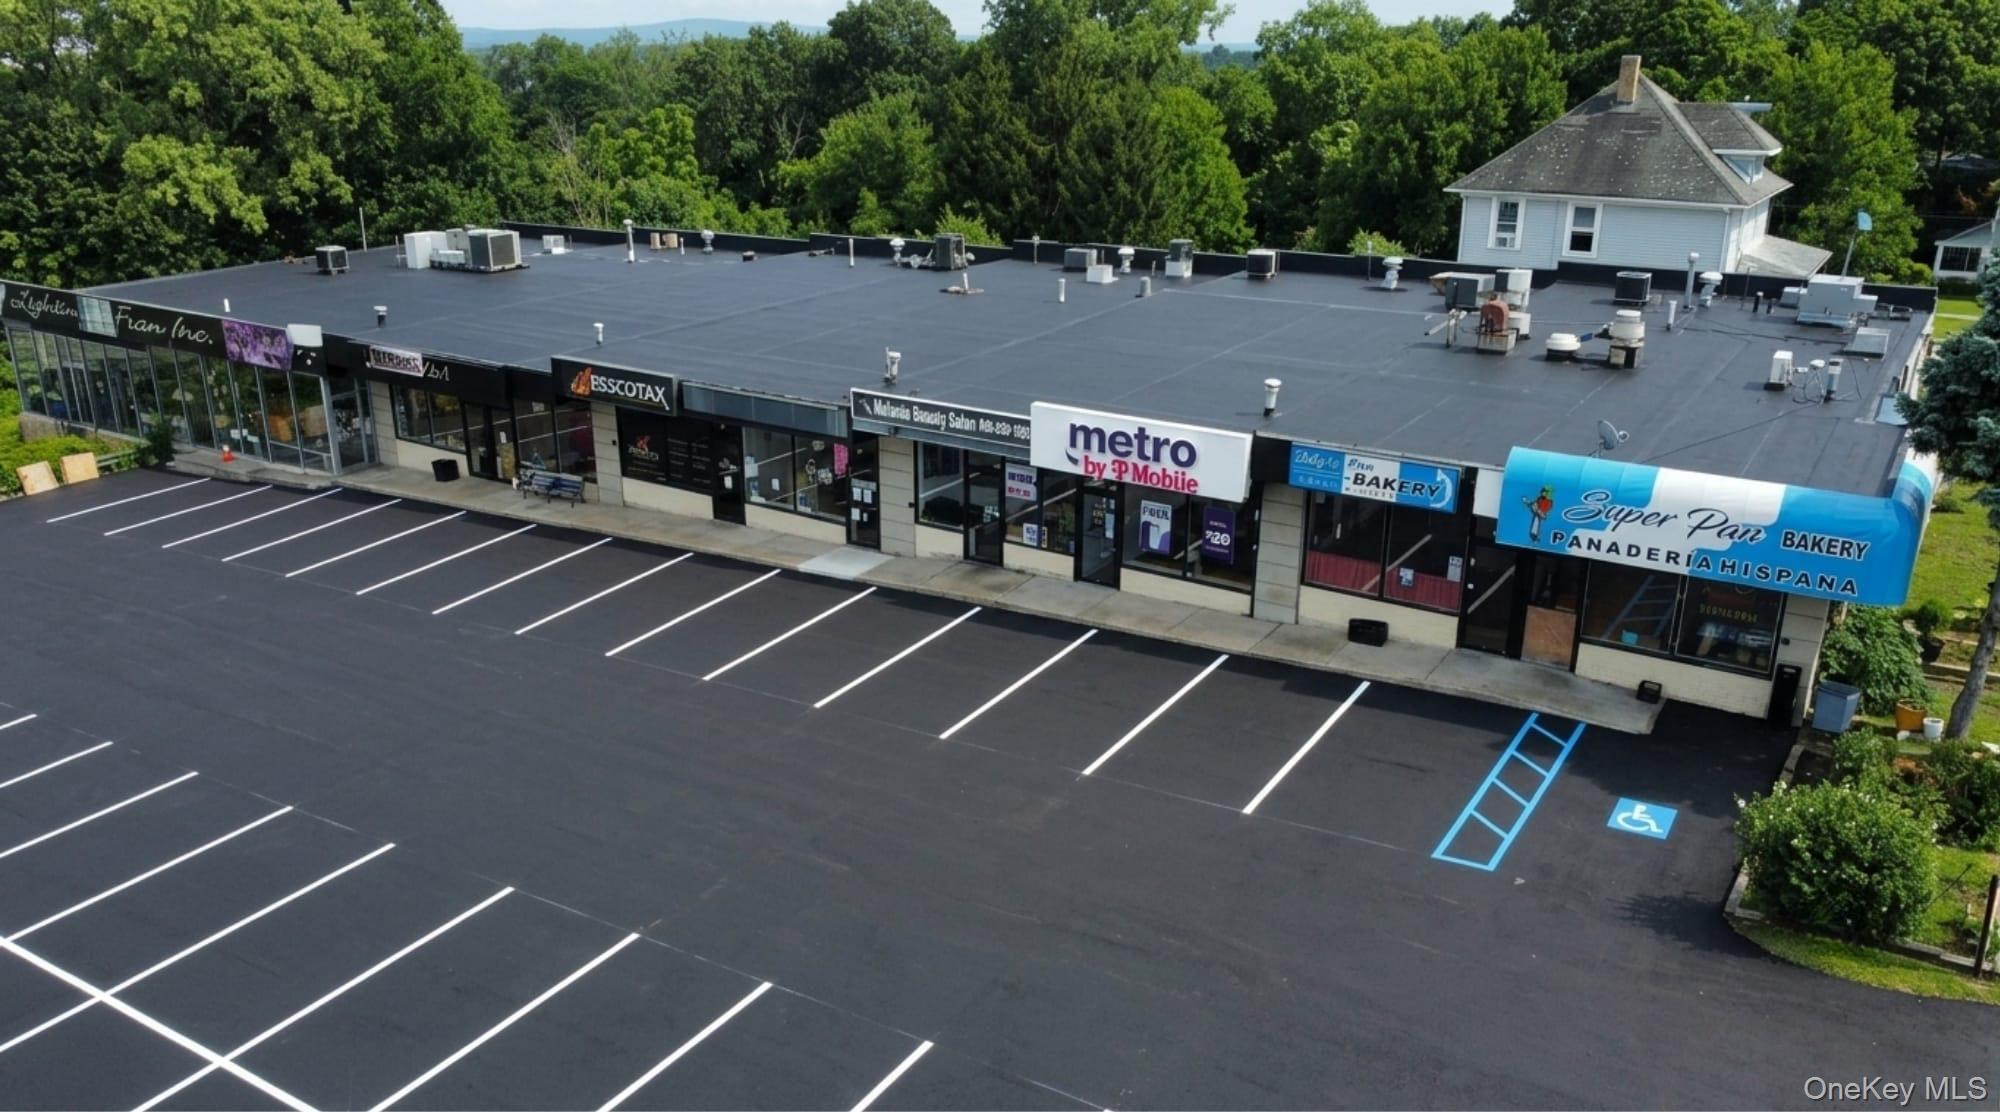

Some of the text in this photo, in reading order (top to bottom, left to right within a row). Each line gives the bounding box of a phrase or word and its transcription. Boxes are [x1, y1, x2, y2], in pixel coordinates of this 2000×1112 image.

[115, 305, 214, 345] Fran Inc.
[1069, 423, 1197, 468] metro
[1083, 454, 1106, 481] by
[1353, 472, 1440, 497] BAKERY
[1564, 490, 1871, 561] Super Pan BAKERY
[1720, 557, 1857, 596] HISPANA
